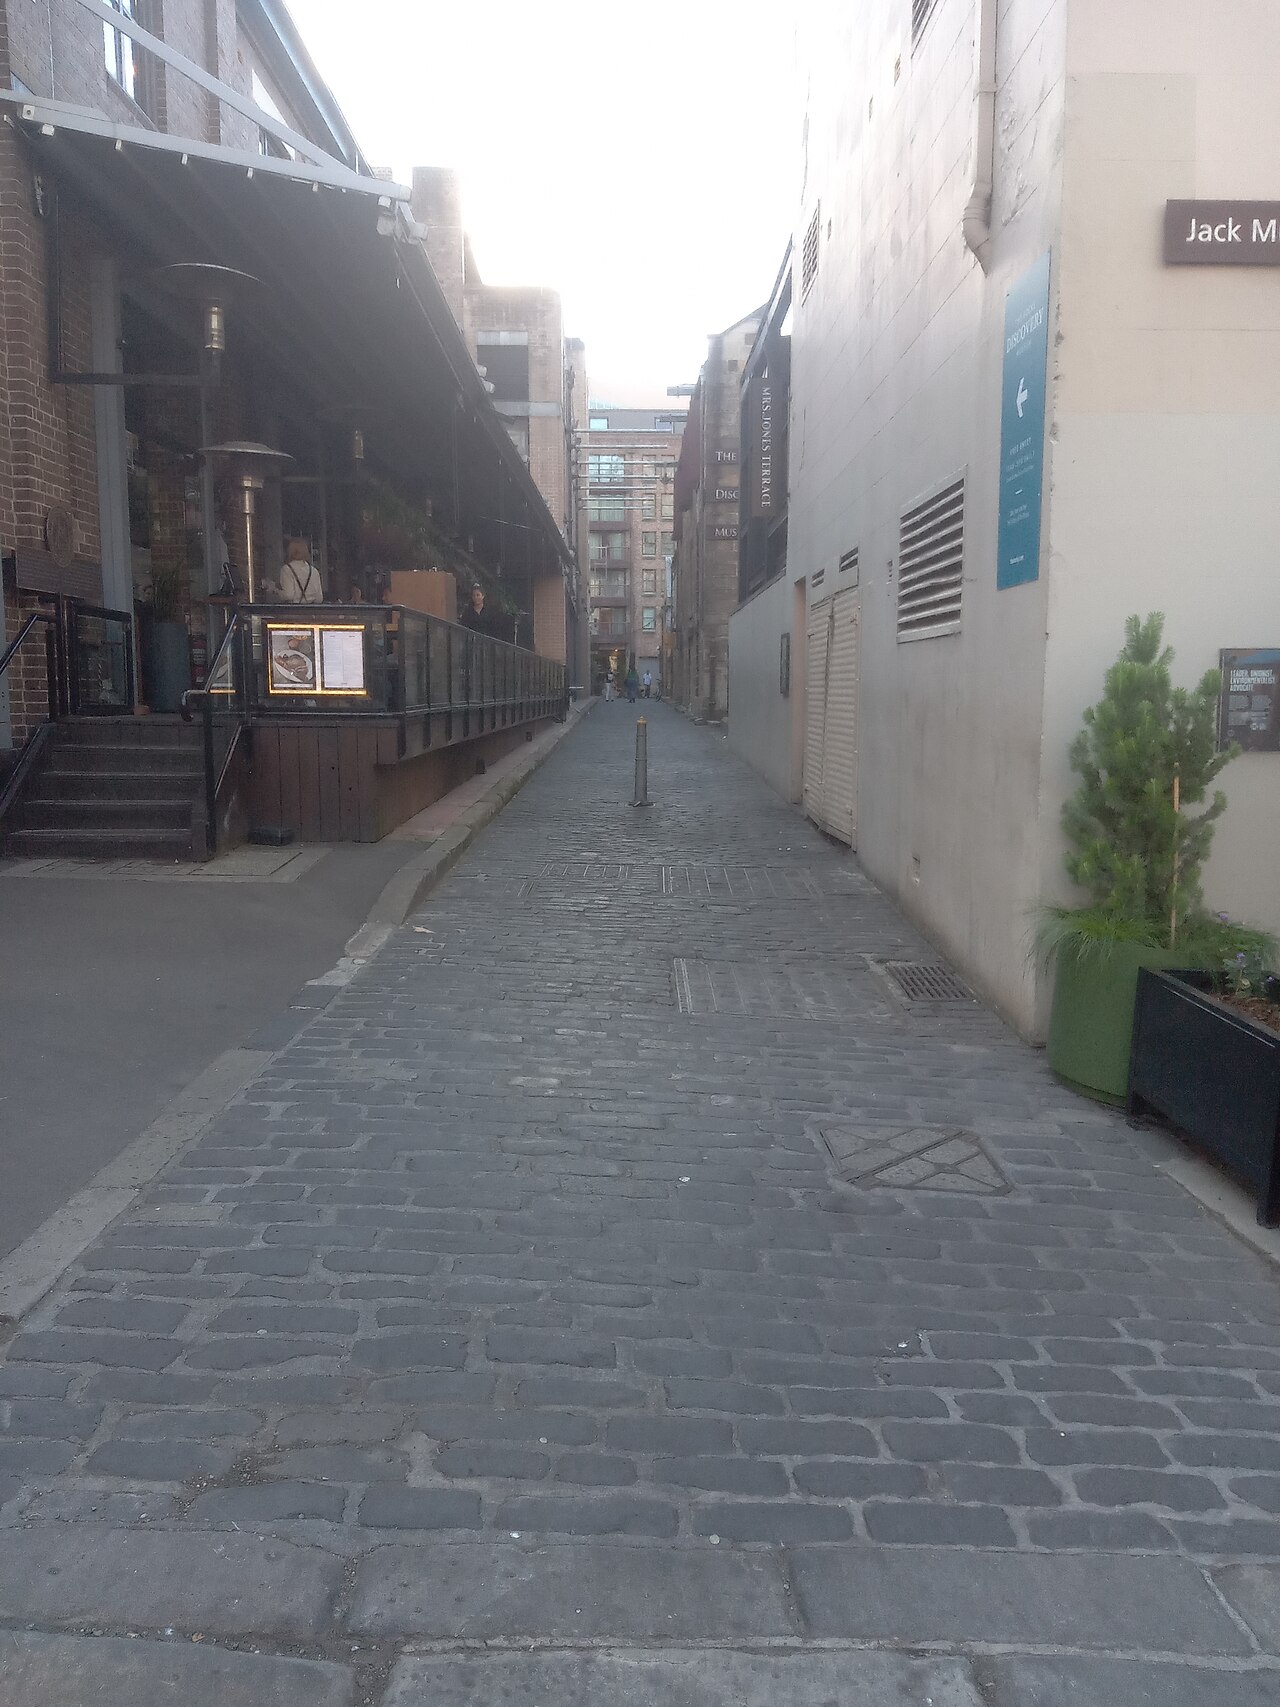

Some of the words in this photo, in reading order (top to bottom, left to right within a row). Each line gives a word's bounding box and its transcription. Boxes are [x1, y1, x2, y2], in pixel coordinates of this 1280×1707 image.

[1186, 217, 1241, 242] Jack
[1252, 218, 1280, 242] M
[716, 451, 737, 461] THE
[761, 455, 771, 507] TERRACE
[715, 489, 739, 499] DISC
[715, 528, 738, 537] MUS
